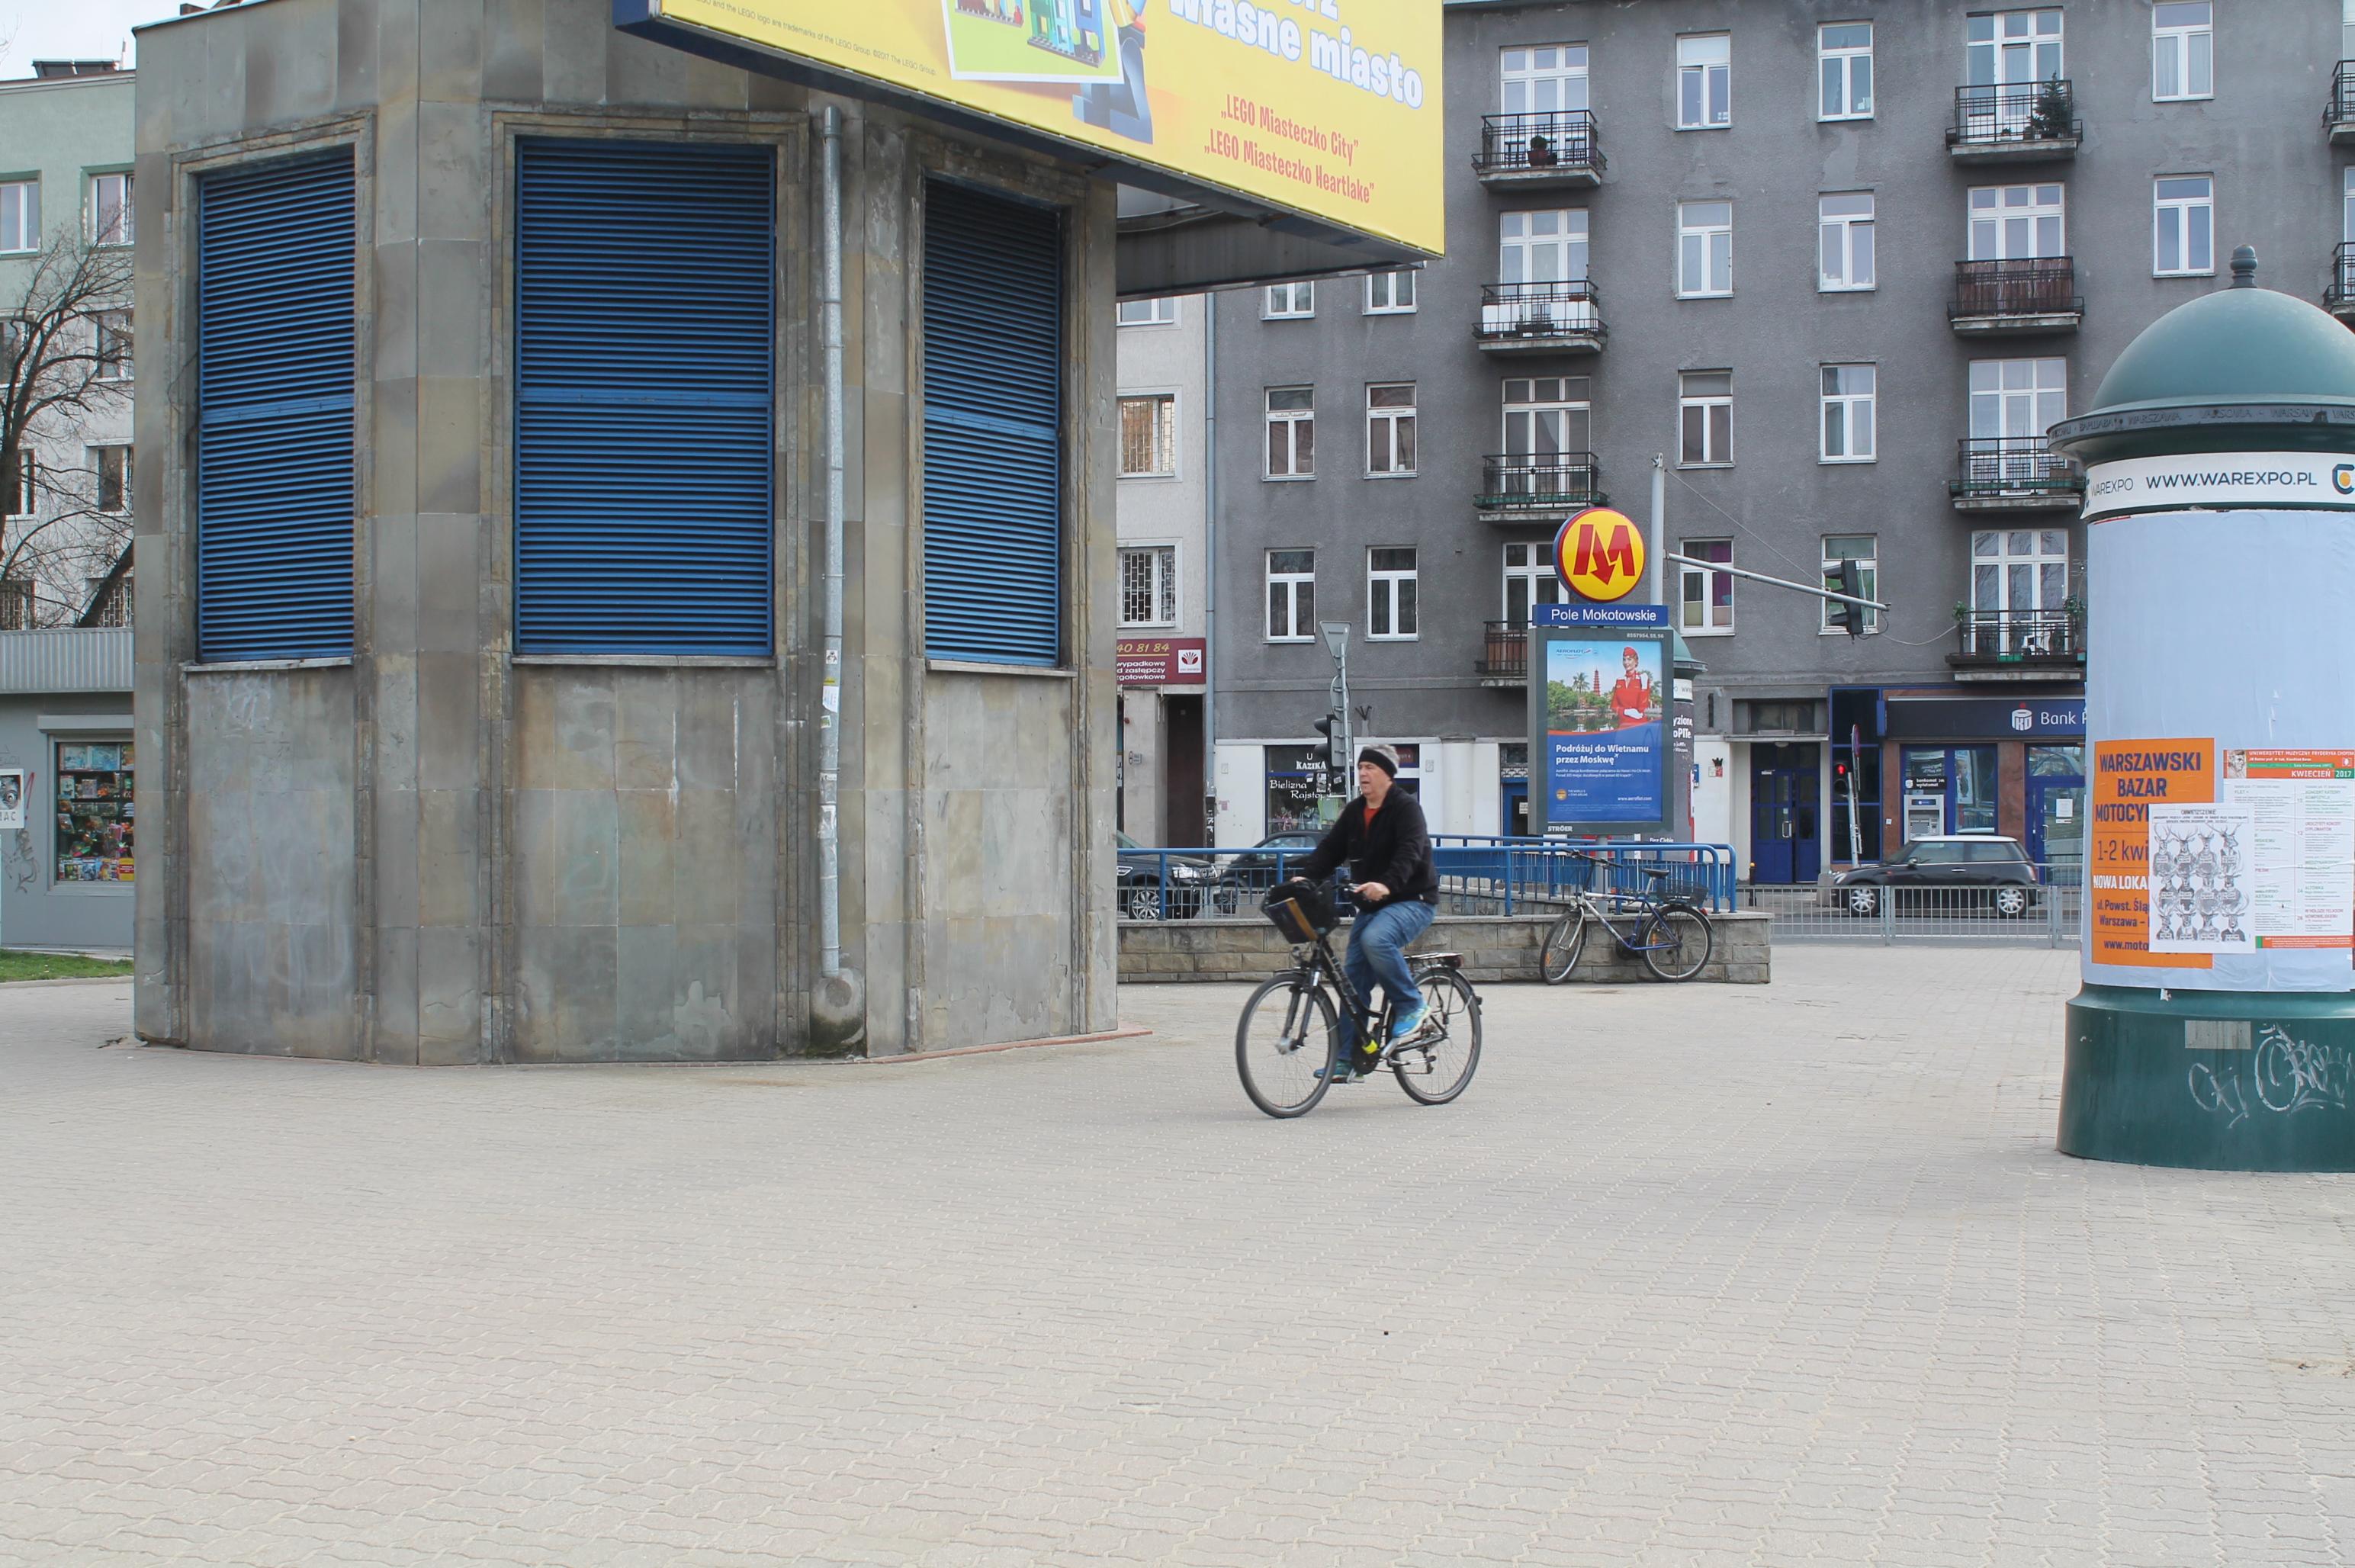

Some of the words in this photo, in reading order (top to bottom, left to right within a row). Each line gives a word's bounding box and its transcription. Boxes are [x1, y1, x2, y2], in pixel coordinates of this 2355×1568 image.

[726, 3, 737, 13] the
[737, 7, 756, 20] LEGO
[757, 14, 771, 25] logo
[835, 38, 853, 50] LEGO
[901, 59, 918, 70] LEGO
[1309, 25, 1423, 109] miasto
[1260, 106, 1327, 152] Miasteczko
[1243, 140, 1312, 185] Miasteczko
[2146, 472, 2318, 489] WWW.WAREXPO.PL
[1551, 609, 1579, 621] Pole
[1582, 609, 1656, 621] Mokotowskie
[1136, 643, 1149, 653] 81
[1153, 642, 1170, 653] 84
[2041, 711, 2076, 725] Bank
[1306, 752, 1313, 760] U
[1556, 744, 1593, 754] Podróżuj
[1595, 744, 1606, 753] do
[1608, 744, 1650, 753] Wietnamu
[1296, 760, 1327, 770] KAZIKA
[1556, 757, 1579, 765] przez
[1580, 755, 1614, 765] Moskwę
[2099, 752, 2201, 772] WARSZAWSKI
[2291, 768, 2331, 778] KWIECIEŃ
[2335, 770, 2352, 778] 2017
[1269, 779, 1307, 789] Bielizna
[2117, 777, 2167, 797] BAZAR
[2097, 839, 2117, 861] 1-2
[2093, 875, 2118, 889] NOWA
[2105, 899, 2132, 911] Powst.
[2133, 897, 2149, 914] Ślą
[2099, 914, 2138, 927] Warszawa
